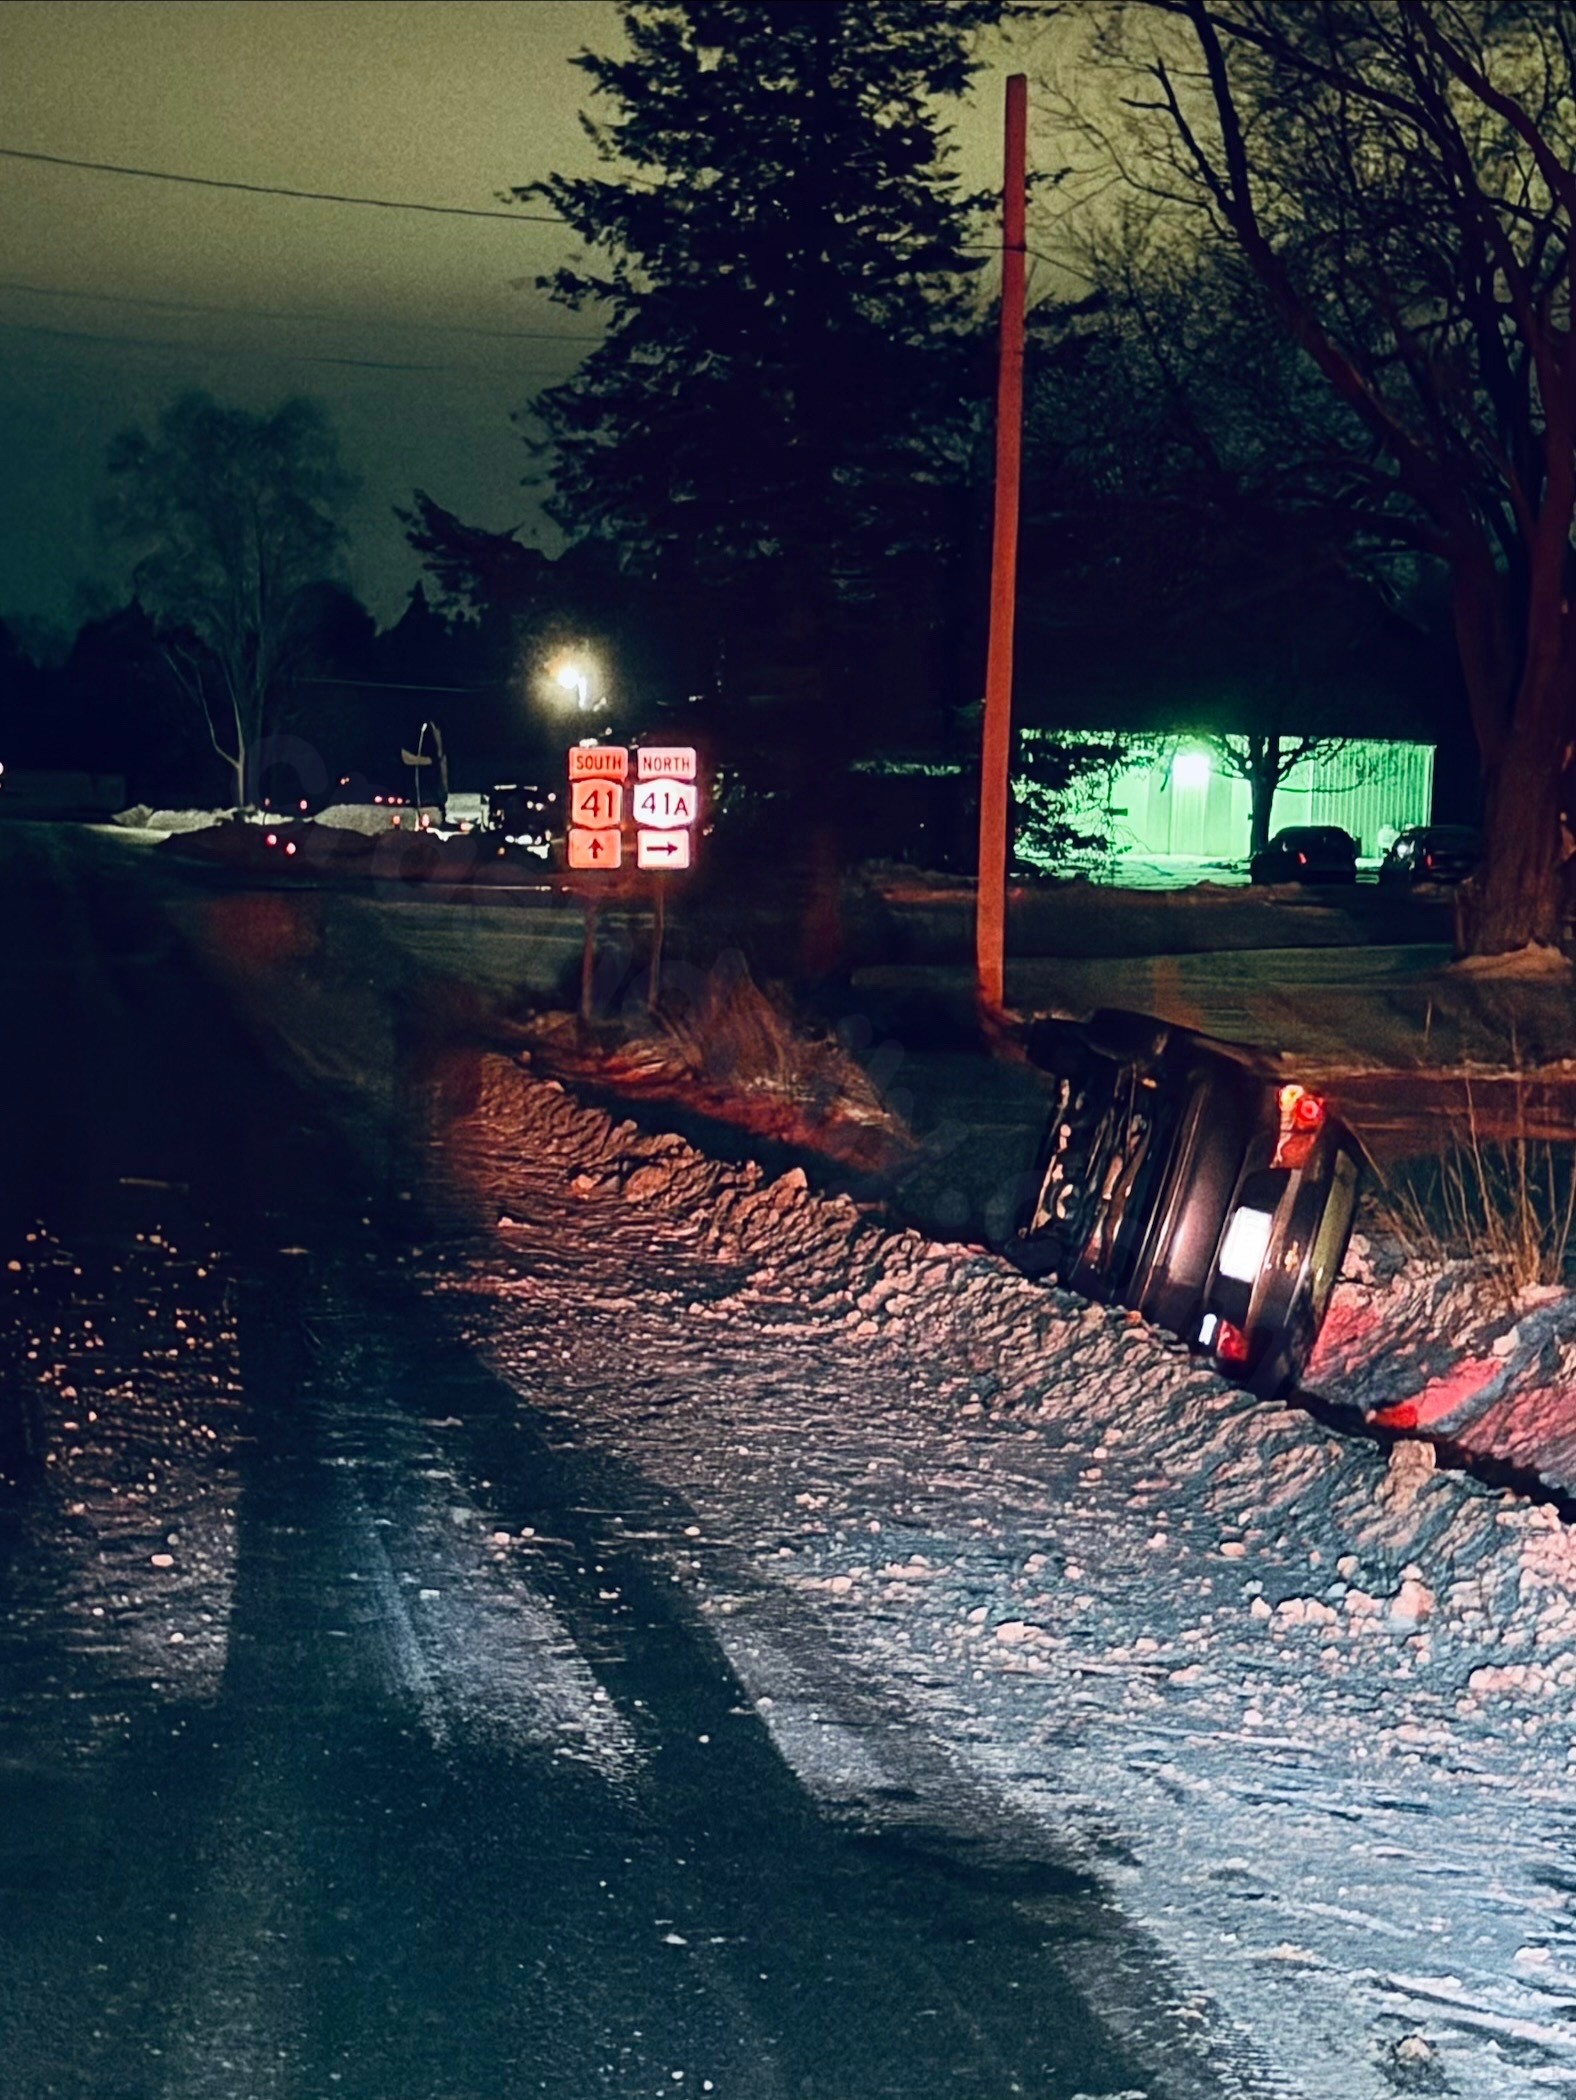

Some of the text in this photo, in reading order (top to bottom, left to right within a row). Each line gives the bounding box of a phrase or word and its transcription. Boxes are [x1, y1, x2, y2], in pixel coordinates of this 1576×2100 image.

[577, 755, 621, 770] SOUTH
[643, 756, 689, 771] NORTH
[581, 790, 612, 818] 41
[641, 792, 689, 816] 41A
